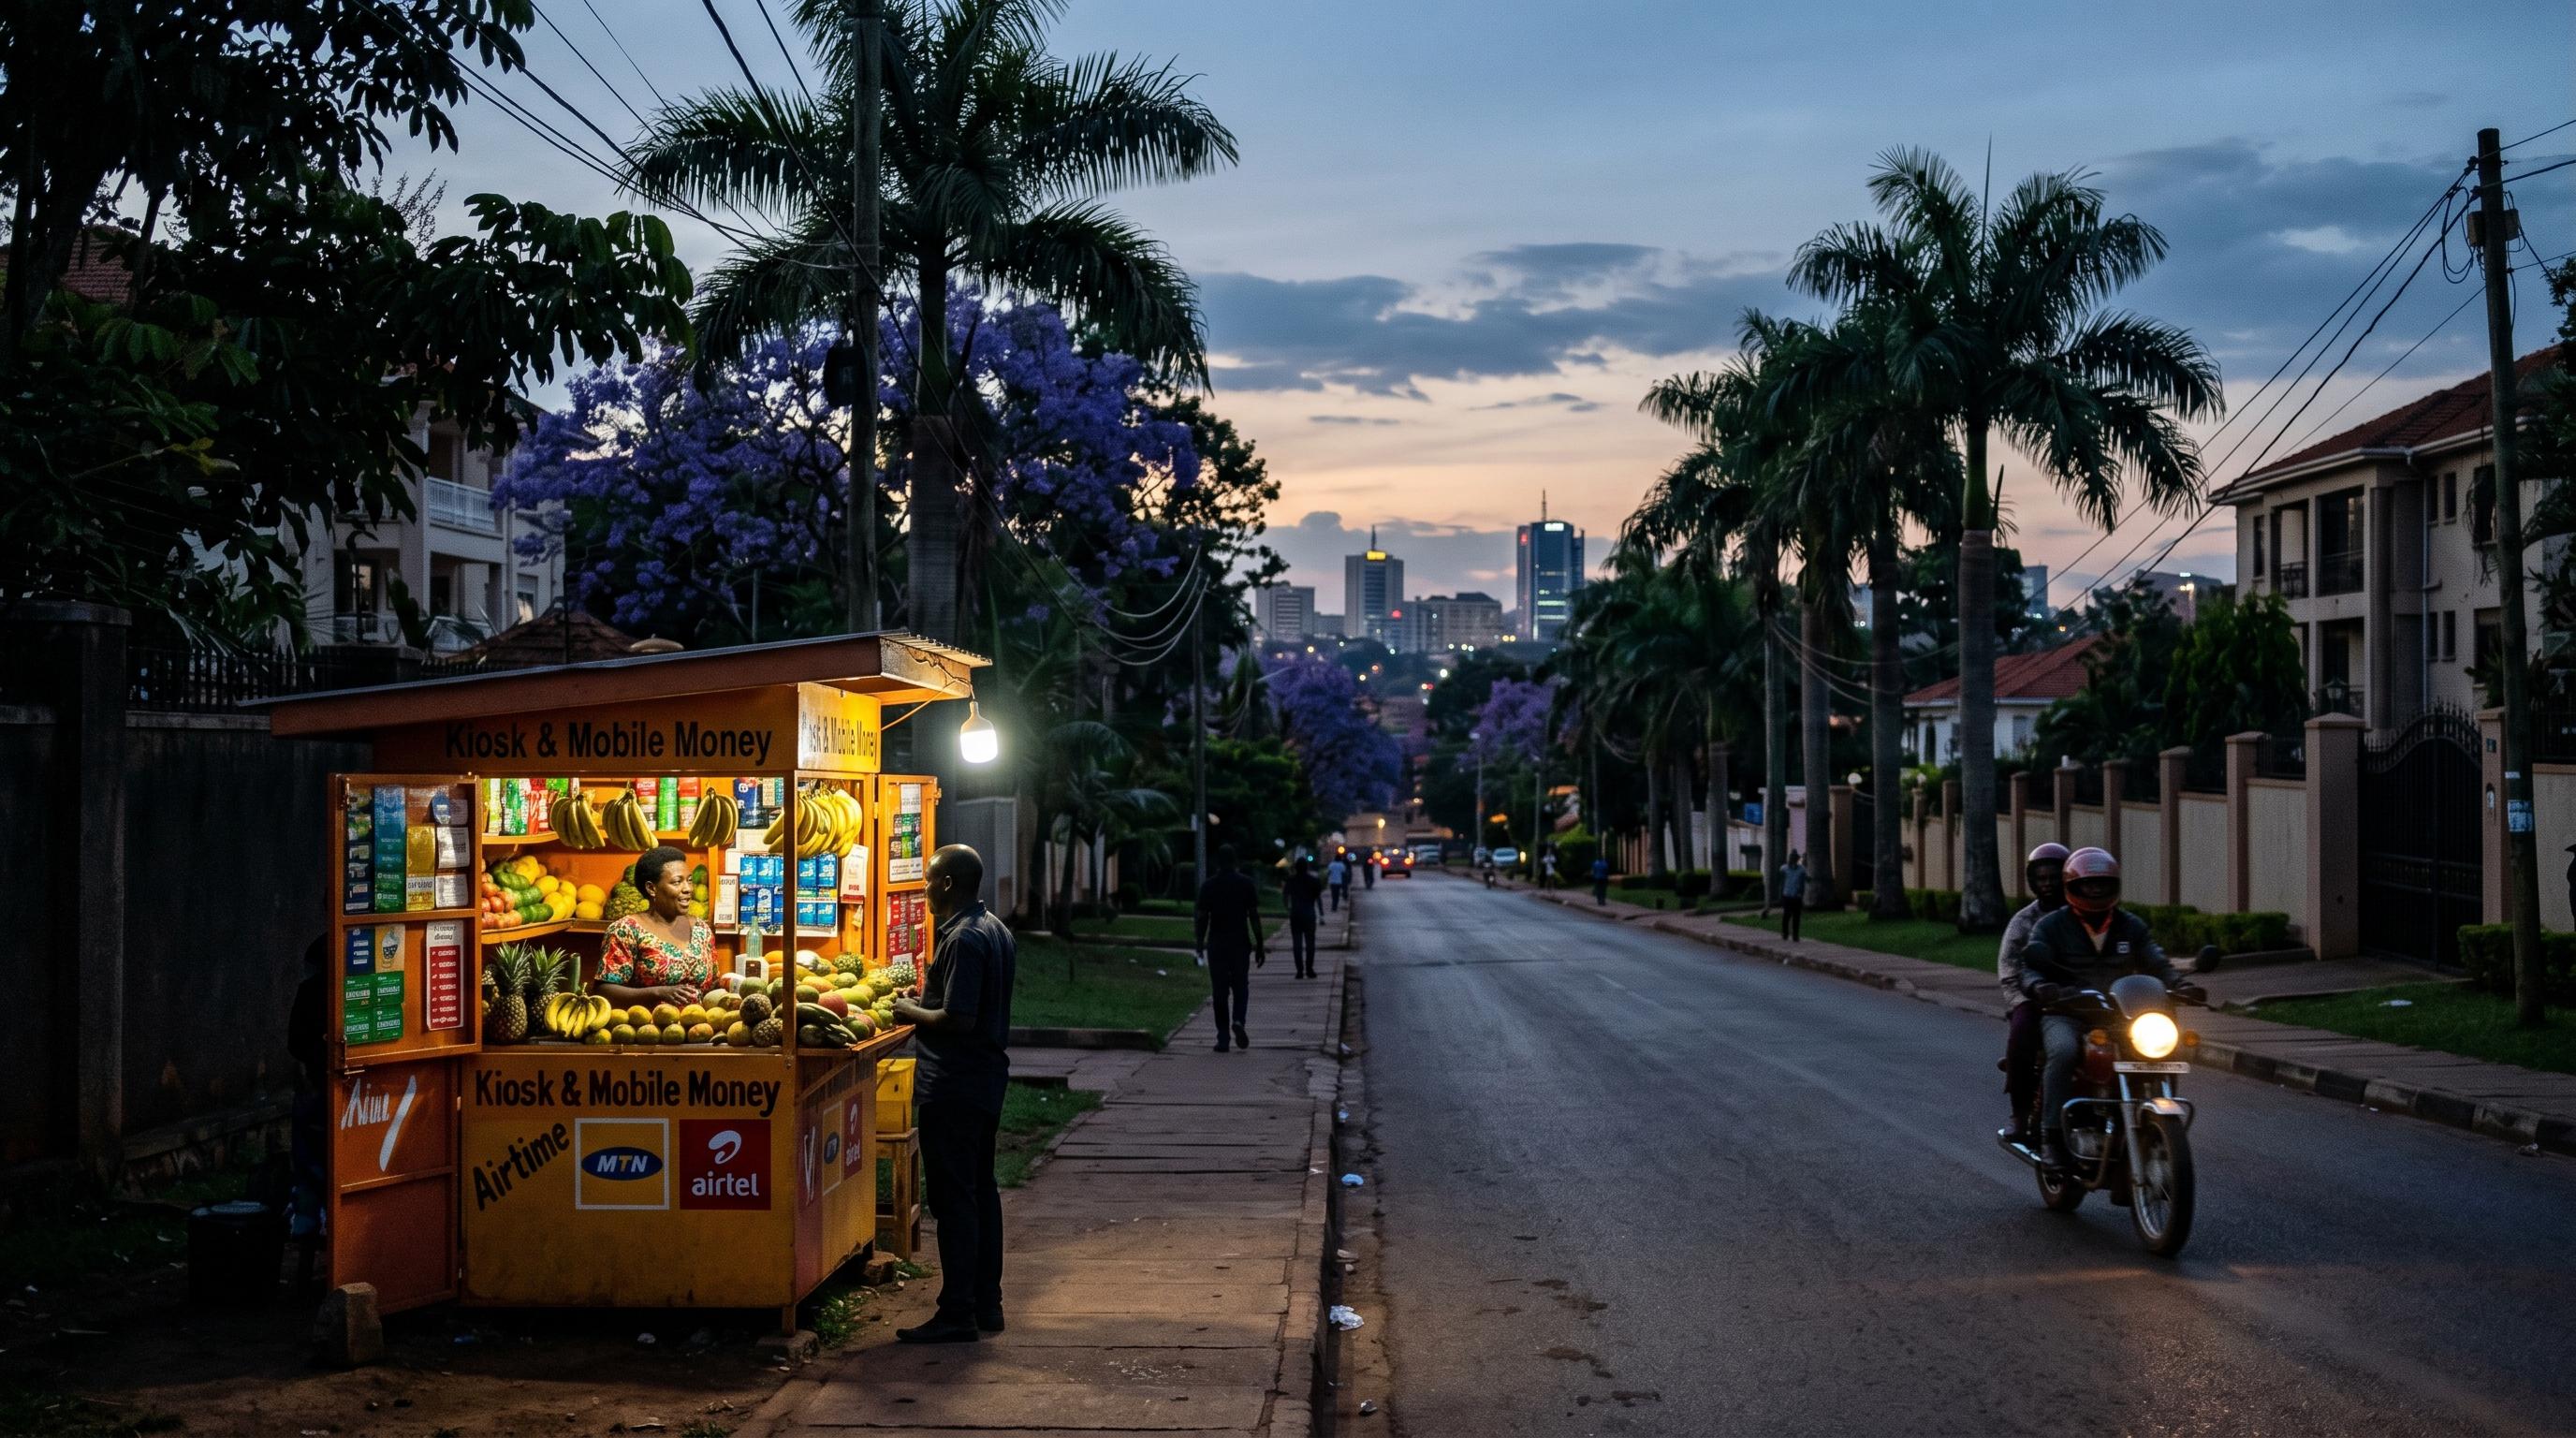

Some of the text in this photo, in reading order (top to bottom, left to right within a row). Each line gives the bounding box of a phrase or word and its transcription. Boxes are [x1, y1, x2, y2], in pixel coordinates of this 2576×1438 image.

[446, 720, 772, 767] Kiosk & Mobile Money
[475, 1069, 555, 1107] Kiosk
[561, 1070, 582, 1107] &
[589, 1069, 681, 1107] Mobile
[688, 1070, 781, 1118] Money
[472, 1123, 570, 1211] Airtime
[596, 1154, 649, 1173] MTN
[691, 1170, 760, 1196] airtel
